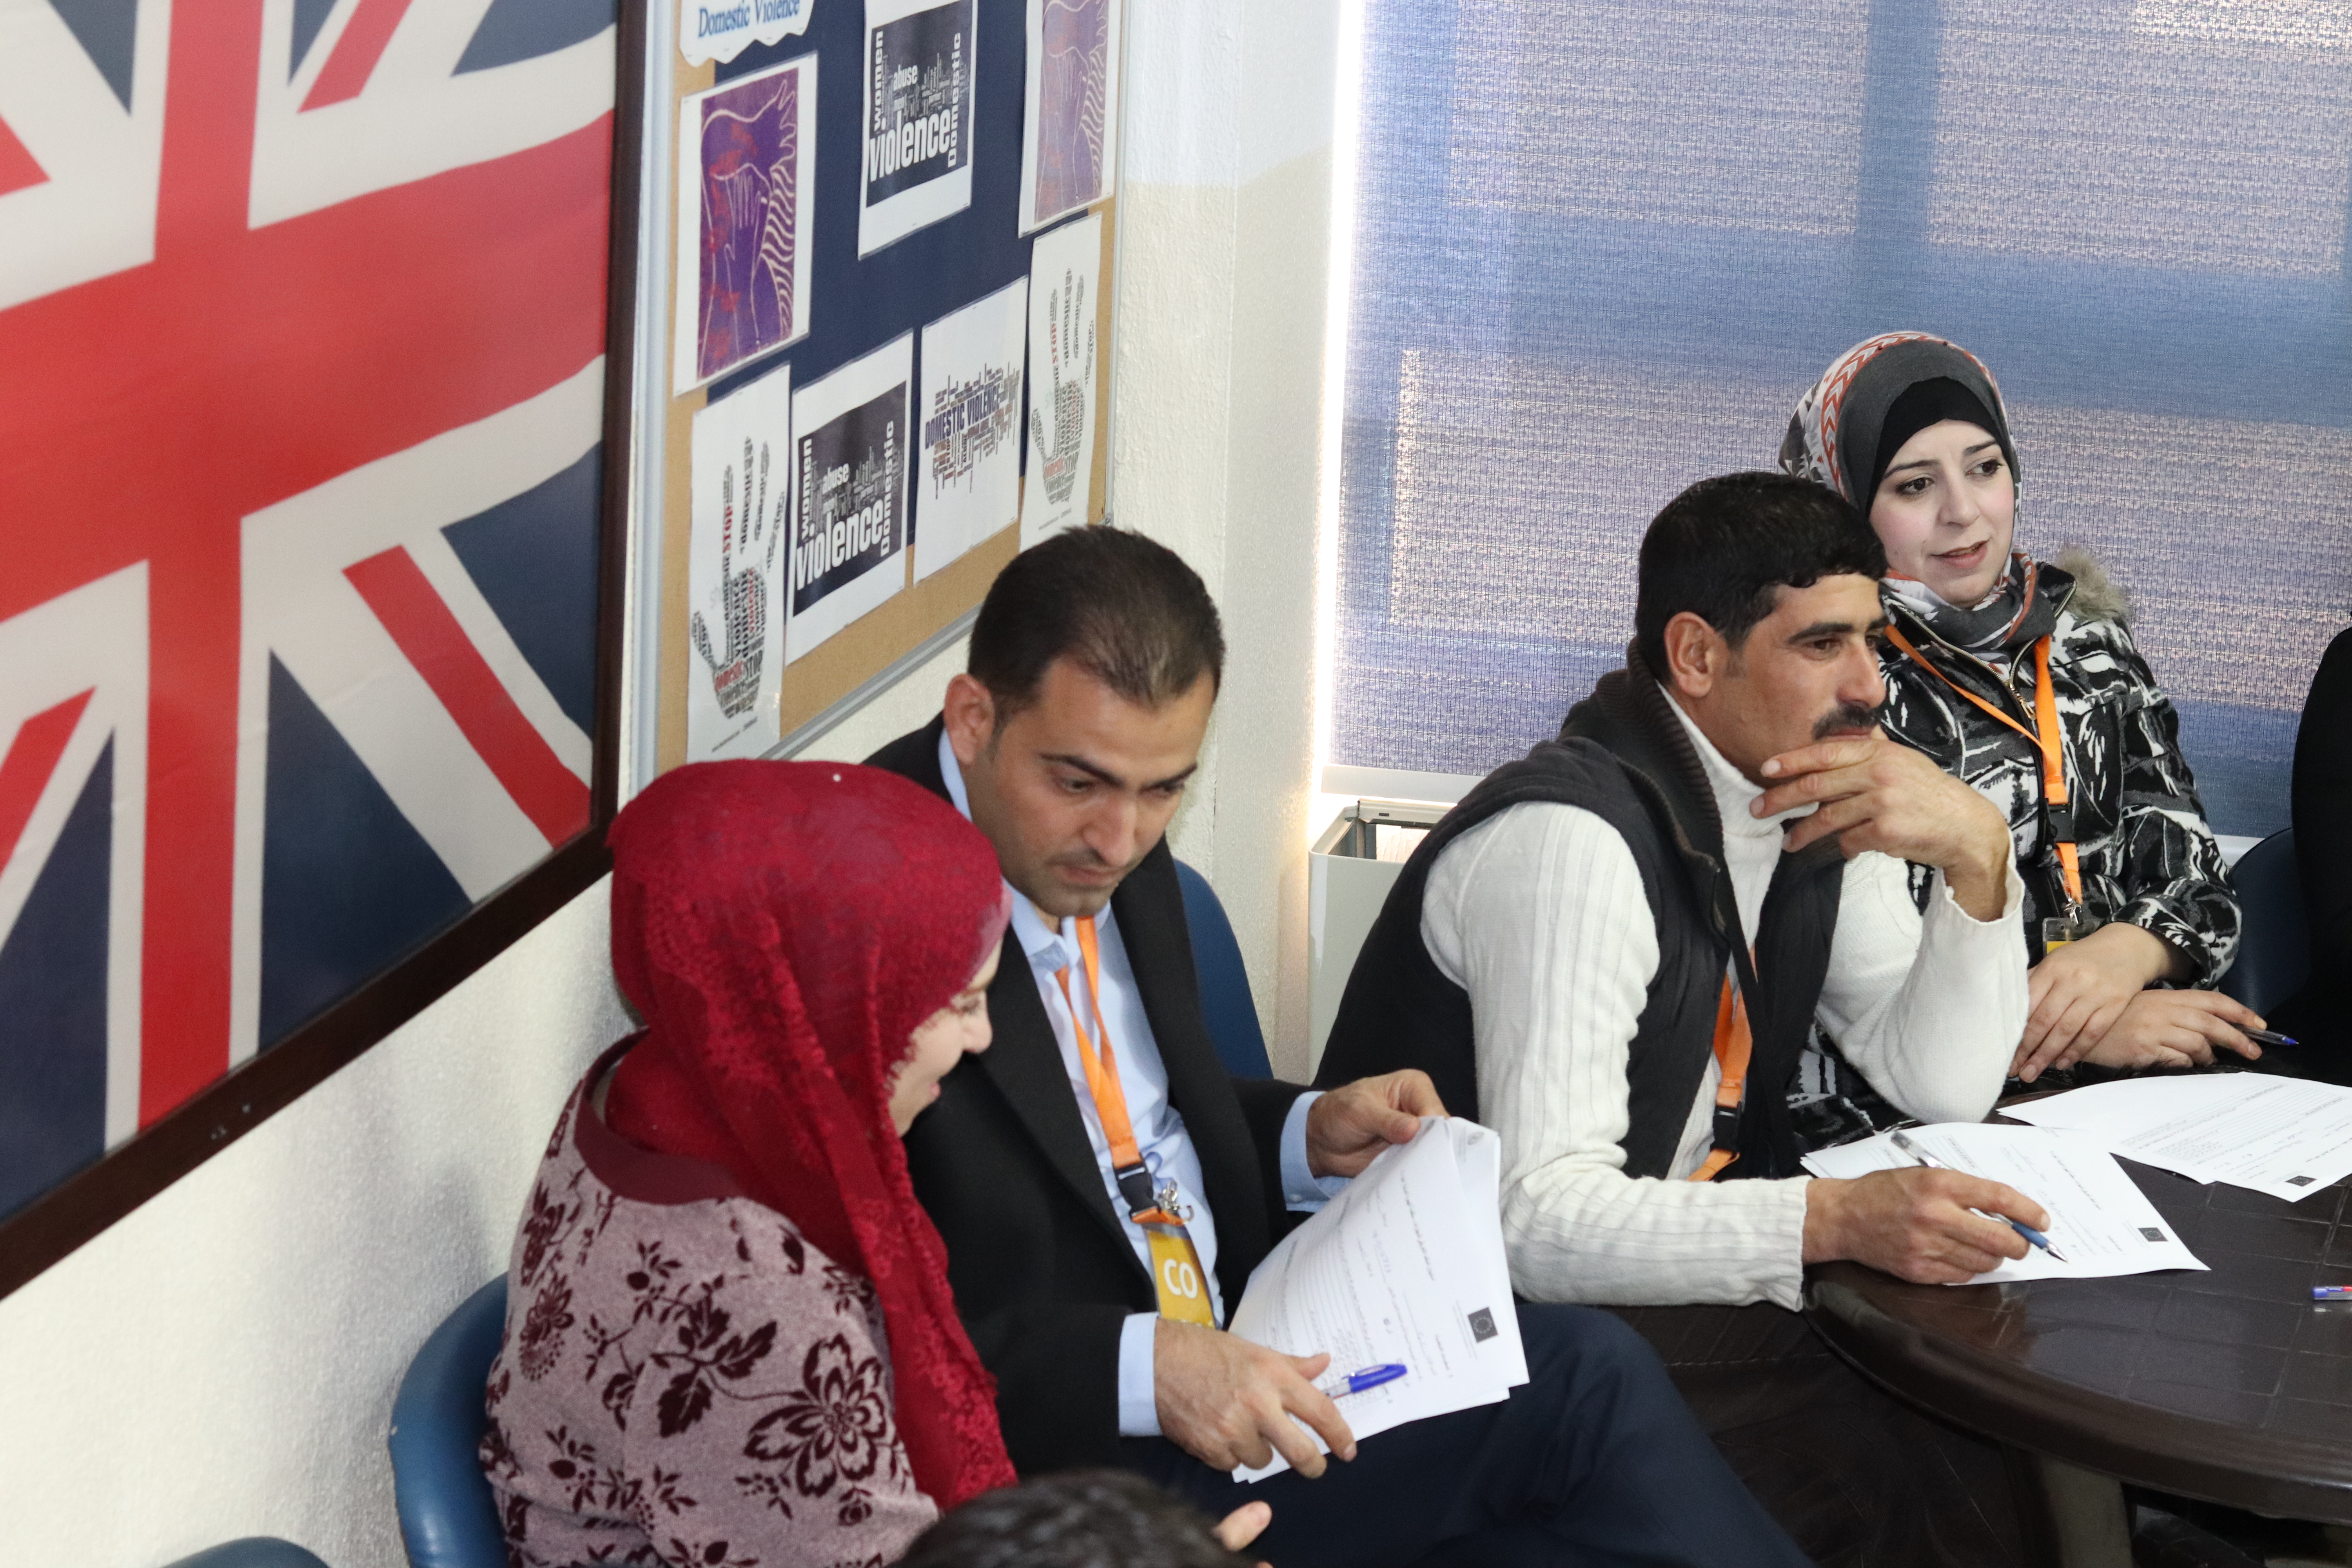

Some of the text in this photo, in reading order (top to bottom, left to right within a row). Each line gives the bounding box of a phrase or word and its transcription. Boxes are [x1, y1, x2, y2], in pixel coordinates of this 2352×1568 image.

[698, 0, 799, 38] Domestic Violence
[874, 31, 883, 132] women
[893, 64, 918, 91] abuse
[947, 32, 960, 168] Domestic
[869, 109, 951, 182] violence
[925, 403, 965, 450] DOMESTIC
[967, 385, 999, 426] VIOLENCE
[801, 438, 812, 540] women
[822, 463, 849, 495] abuse
[880, 420, 893, 557] Domestic
[723, 505, 733, 554] STOP
[796, 499, 884, 591] violence
[1163, 1258, 1198, 1299] CO
